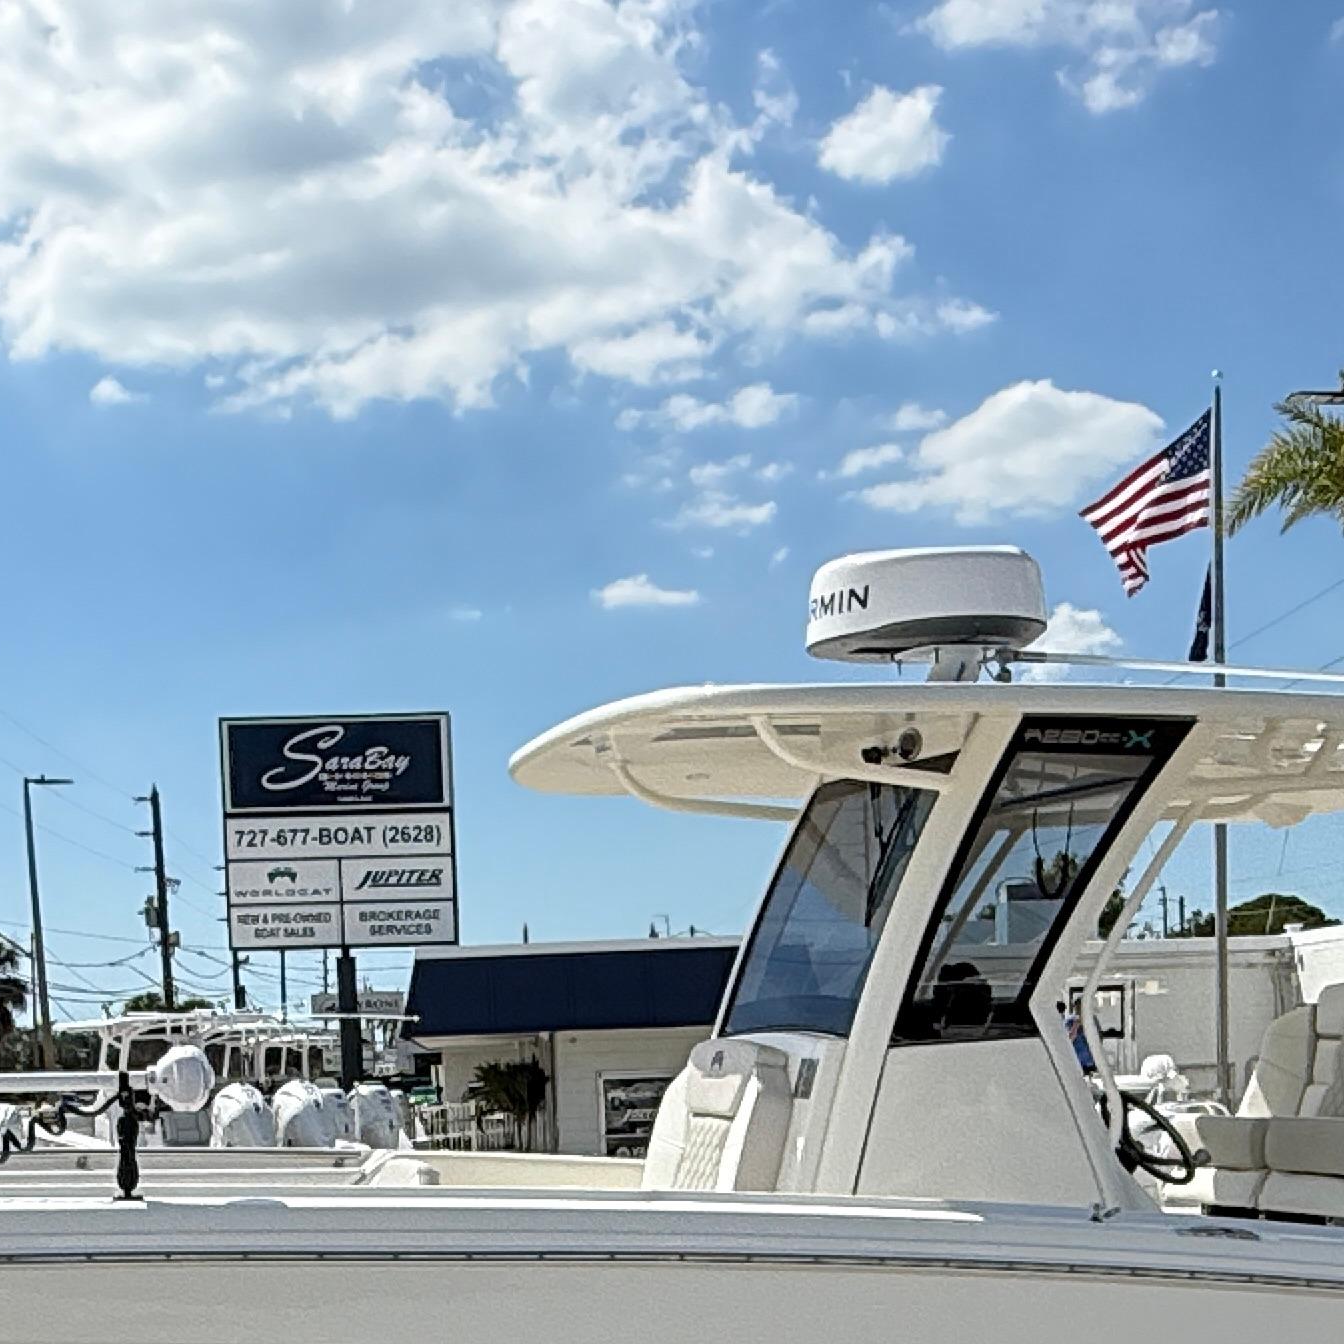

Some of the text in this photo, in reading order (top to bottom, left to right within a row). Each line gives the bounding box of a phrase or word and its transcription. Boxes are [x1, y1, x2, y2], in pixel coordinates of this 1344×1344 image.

[234, 824, 442, 848] 727-677-BOAT (2628)
[354, 869, 444, 890] JUPITER
[237, 914, 260, 926] NEW
[271, 912, 332, 924] PRE-OWNED
[358, 909, 441, 922] BROKERAGE
[254, 926, 316, 939] BOAT SALES
[369, 922, 433, 936] SERVICES
